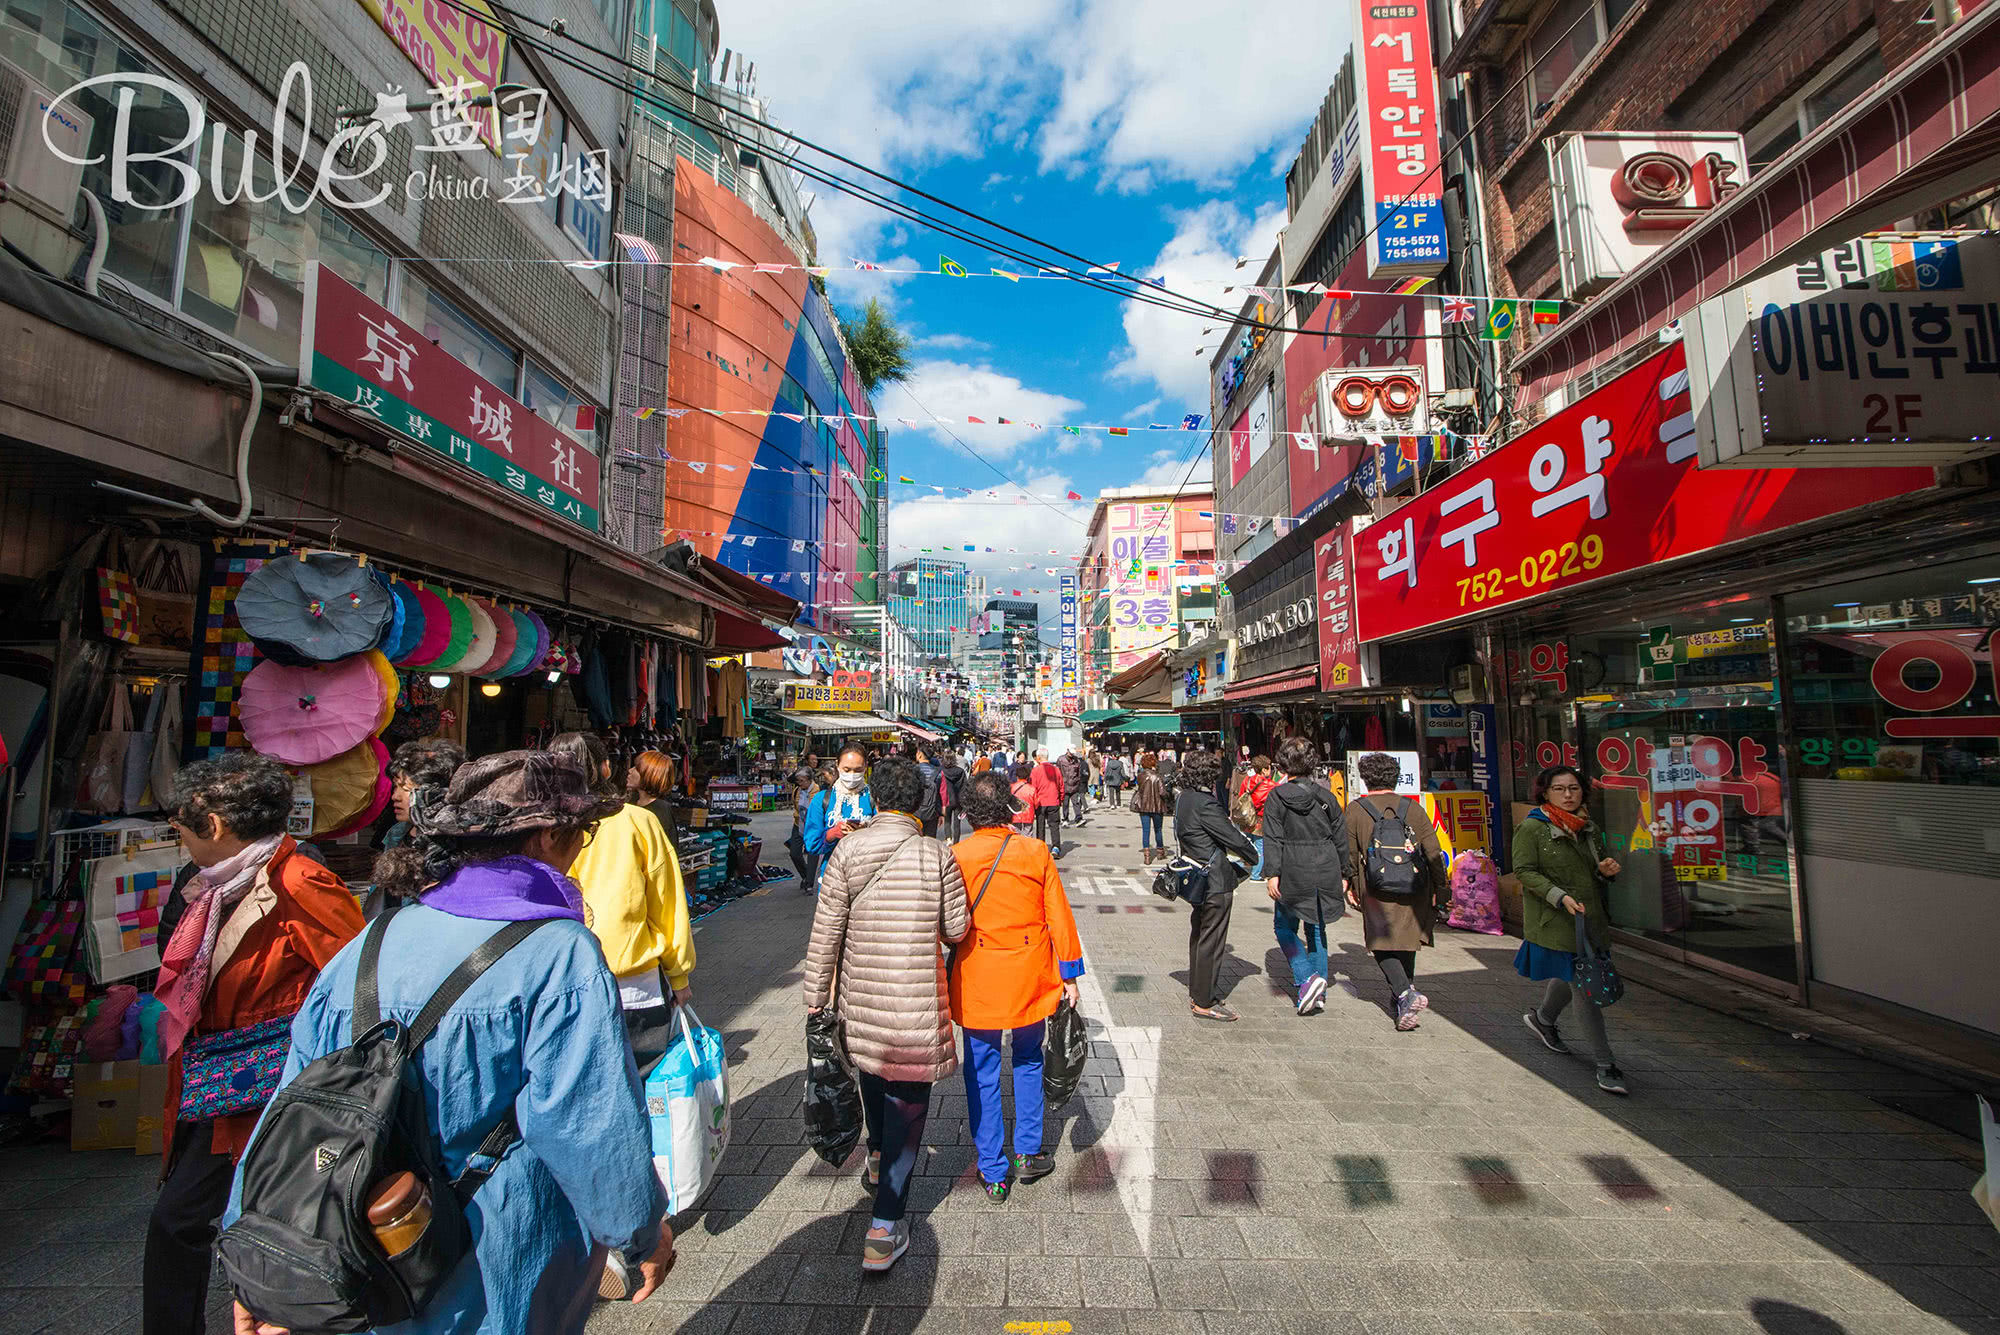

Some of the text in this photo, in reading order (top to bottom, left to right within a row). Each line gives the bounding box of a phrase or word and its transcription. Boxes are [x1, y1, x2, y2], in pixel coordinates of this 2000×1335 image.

[1370, 32, 1427, 176] 서독안경
[1385, 235, 1440, 247] 755-5578
[1385, 247, 1440, 258] 755-1864
[1761, 302, 2000, 382] 이비인후과
[357, 313, 583, 495] 京城社
[1862, 394, 1923, 433] 2F
[505, 465, 583, 520] 경성사
[1111, 504, 1169, 531] 그릇
[1112, 535, 1170, 561] 이불
[1318, 535, 1350, 634] 서독안경
[1456, 534, 1605, 607] 752-0229
[1115, 599, 1171, 626] 3층
[1238, 610, 1284, 648] BLACK
[1335, 668, 1347, 681] 2F
[1428, 718, 1467, 728] essilor
[1597, 737, 1656, 803] 약
[1690, 736, 1768, 815] 약
